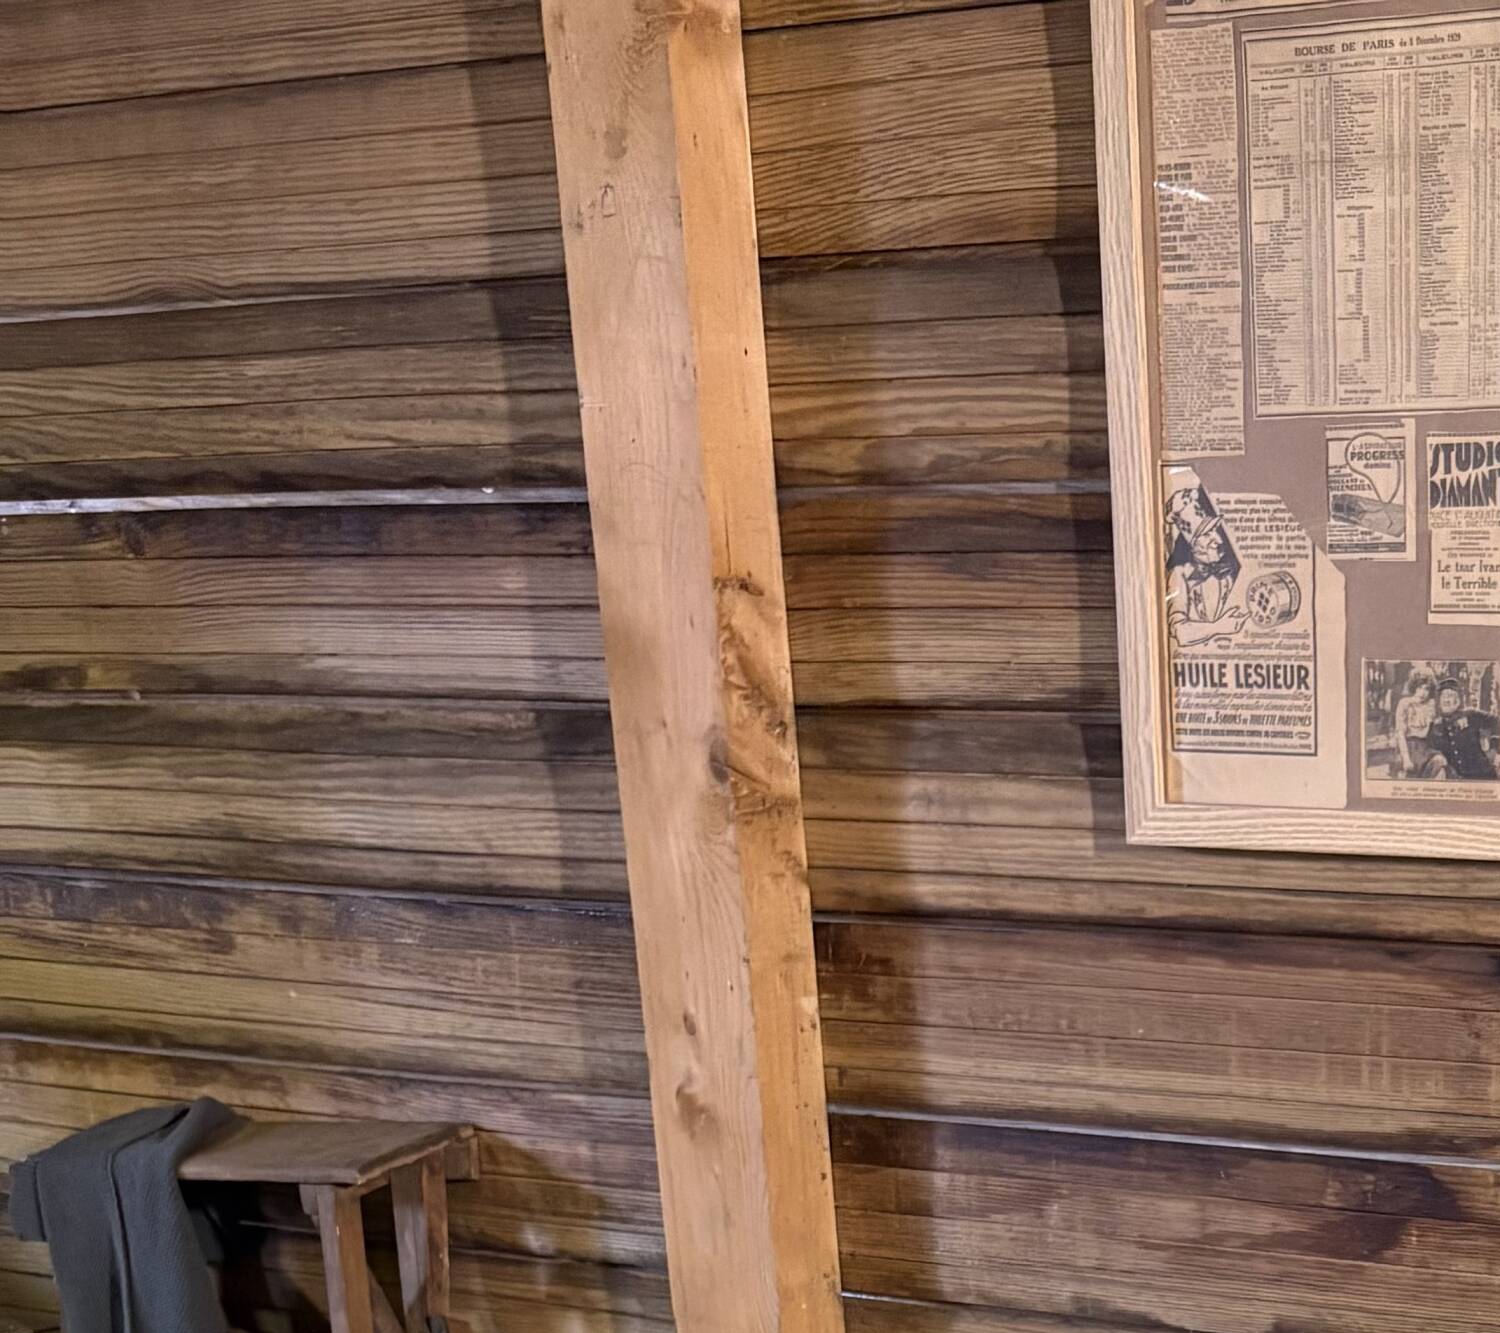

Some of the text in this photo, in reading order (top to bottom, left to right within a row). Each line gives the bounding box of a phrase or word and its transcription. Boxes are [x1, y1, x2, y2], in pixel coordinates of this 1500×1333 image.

[1294, 44, 1335, 57] BOURSE
[1341, 41, 1356, 53] DE
[1363, 38, 1395, 51] PARIS
[1350, 450, 1405, 461] PROGRESS
[1437, 560, 1449, 573] Le
[1453, 576, 1499, 590] Terrible
[1173, 662, 1310, 690] HUILE LESIEUR
